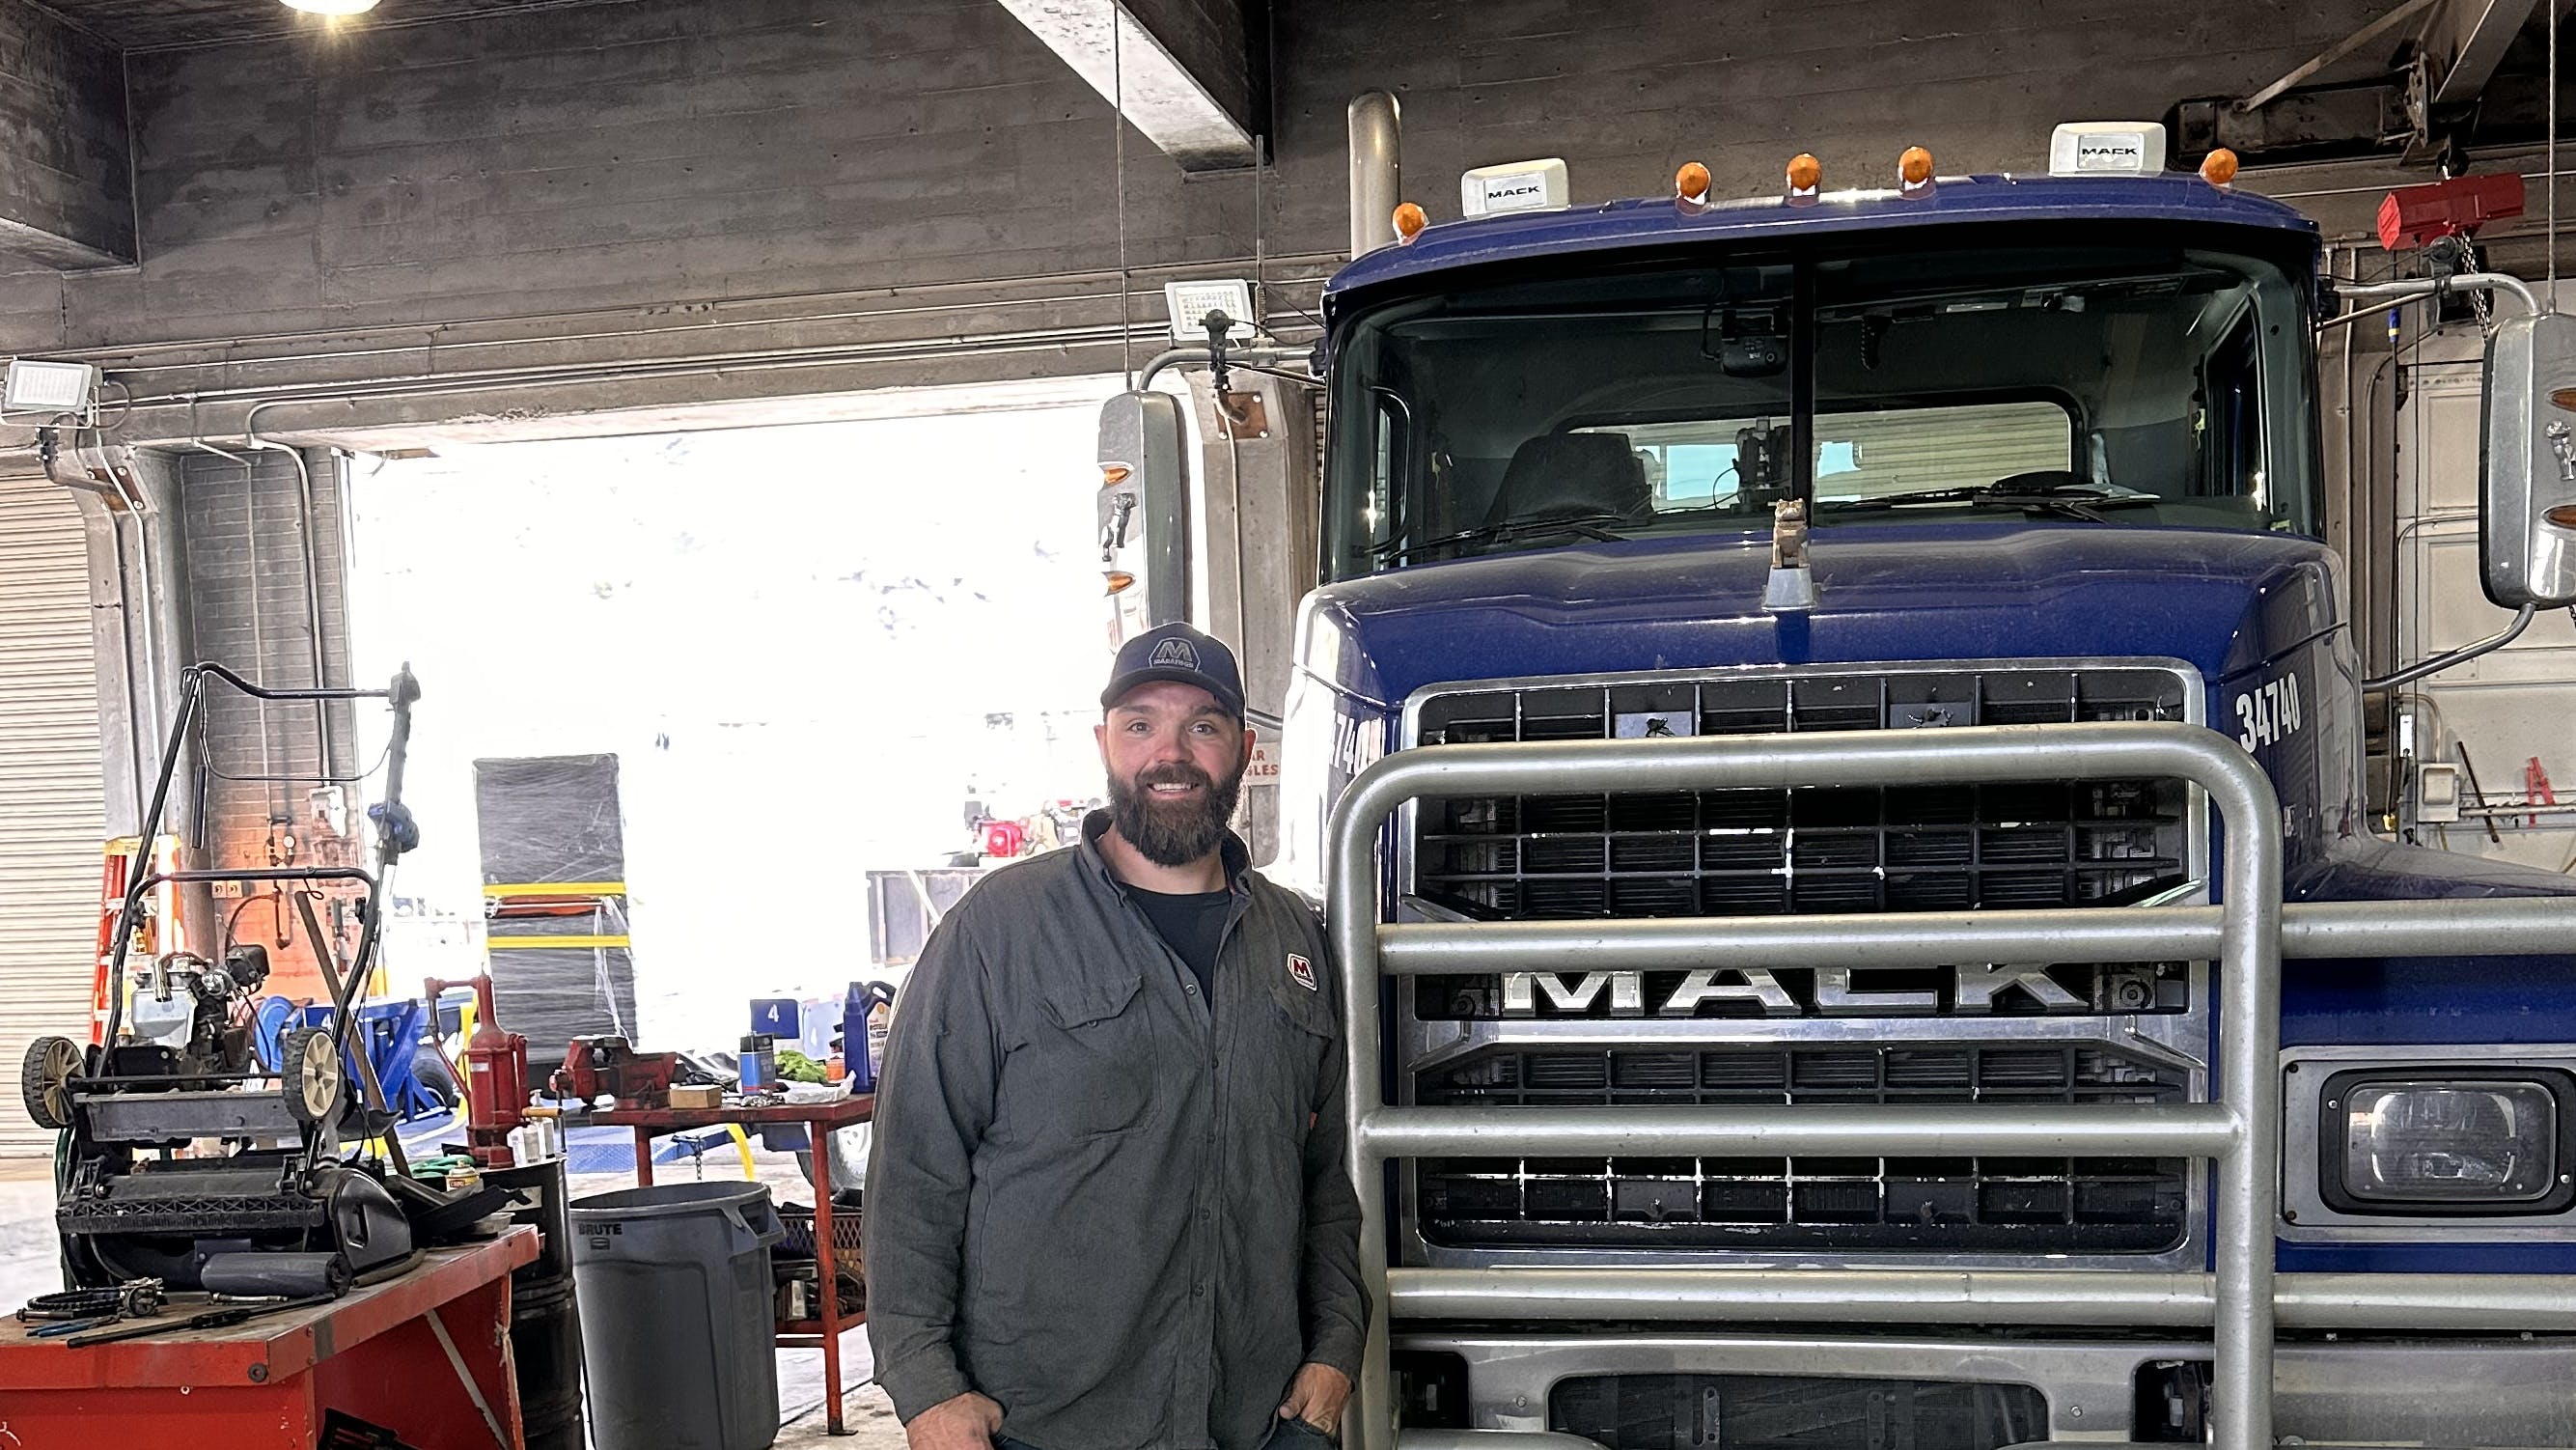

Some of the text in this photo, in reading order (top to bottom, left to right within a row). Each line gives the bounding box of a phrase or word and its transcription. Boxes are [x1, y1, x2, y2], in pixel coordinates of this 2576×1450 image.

[1487, 185, 1541, 199] MACK
[1156, 641, 1193, 662] M
[2235, 672, 2301, 753] 34740
[1293, 959, 1312, 977] M
[1501, 965, 2091, 1015] MACK
[767, 1003, 780, 1022] 4
[579, 1223, 623, 1236] BRUTE
